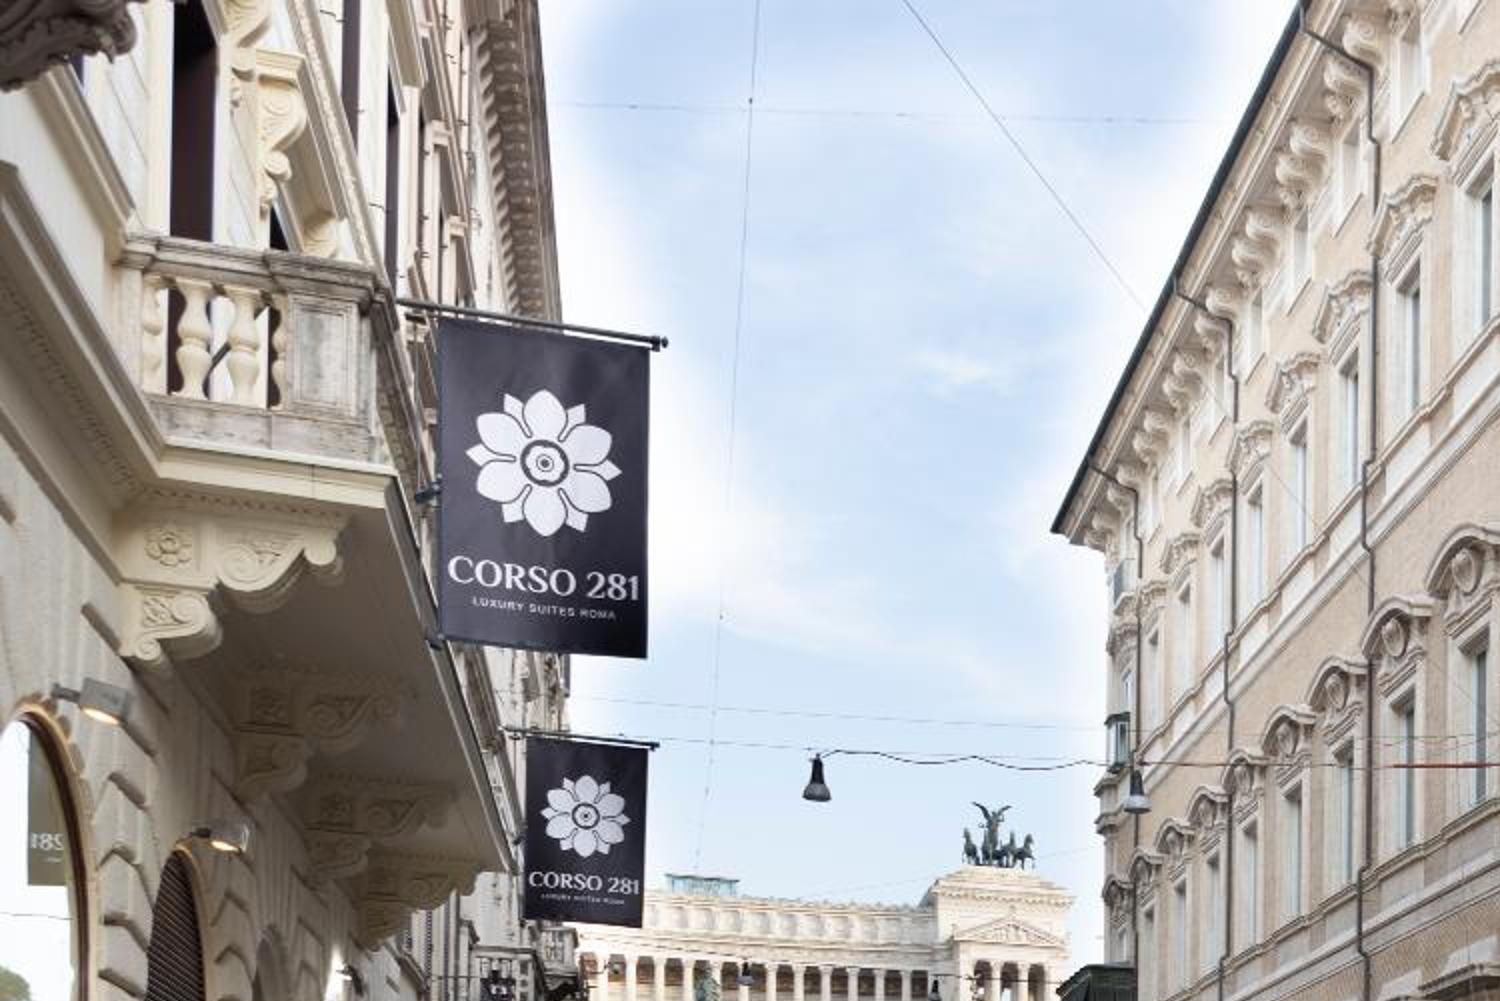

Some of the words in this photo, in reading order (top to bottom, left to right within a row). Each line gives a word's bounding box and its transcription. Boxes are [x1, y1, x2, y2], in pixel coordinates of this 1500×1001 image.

[447, 555, 577, 597] CORSO
[586, 571, 639, 601] 281
[472, 596, 524, 612] LUXURY
[529, 604, 575, 617] SUITES
[528, 871, 603, 891] CORSO
[607, 876, 640, 895] 281
